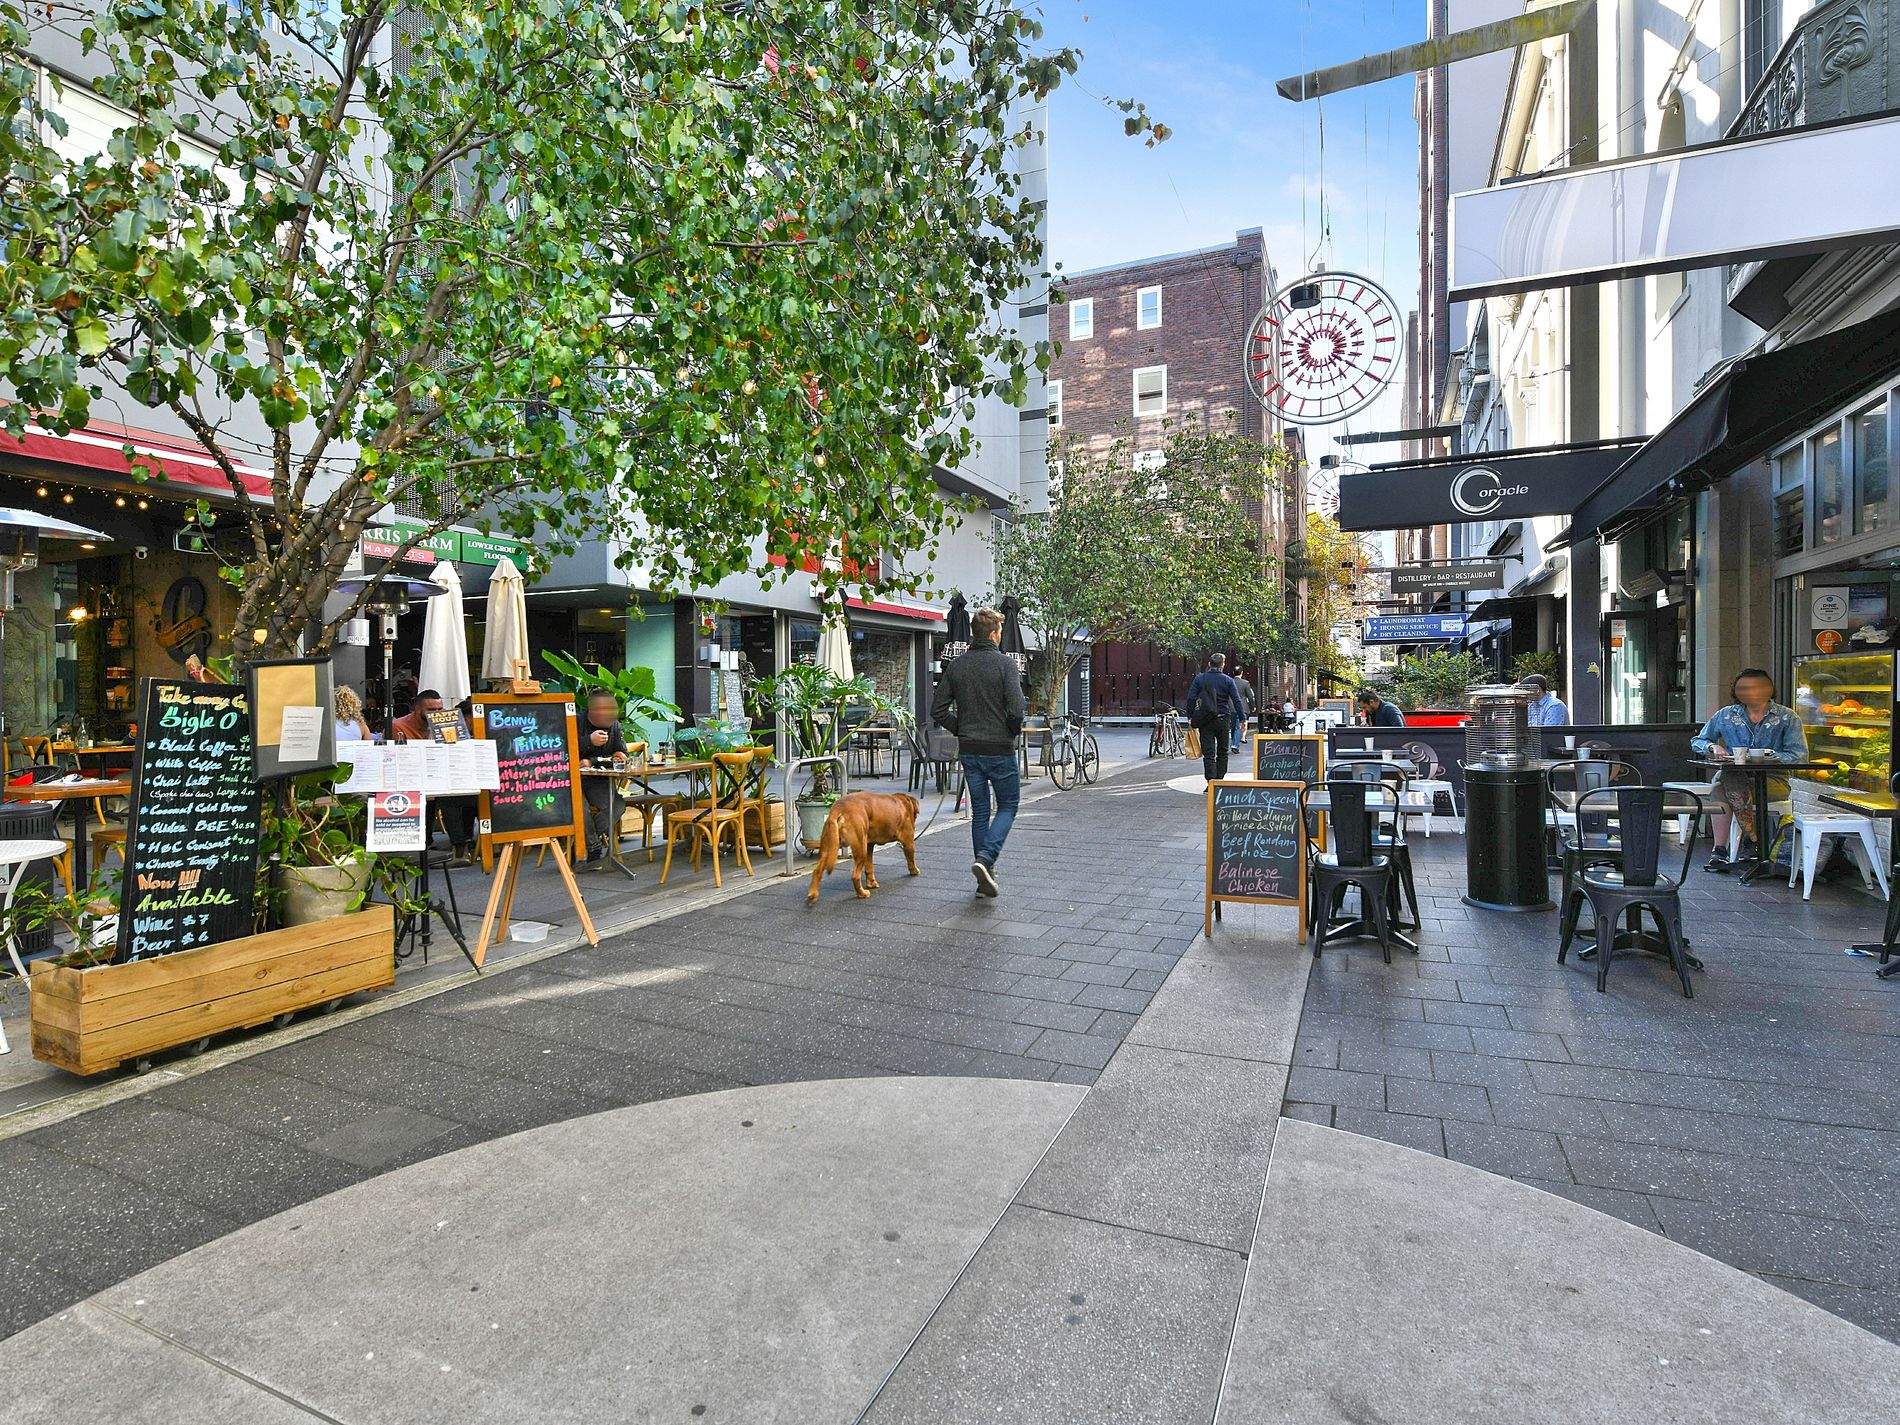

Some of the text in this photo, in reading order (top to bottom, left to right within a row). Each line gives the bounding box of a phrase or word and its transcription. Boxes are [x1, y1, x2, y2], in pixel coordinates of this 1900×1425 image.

[363, 544, 425, 560] MARTS
[467, 540, 521, 555] LOWER GROU
[1398, 571, 1497, 583] DISTILLERY BAR RESTAURANT
[156, 685, 192, 705] Take
[488, 708, 539, 734] Benny
[158, 738, 196, 752] Black
[199, 739, 238, 757] Coffee
[155, 757, 223, 771] White Coffee
[153, 774, 182, 788] Chai
[535, 794, 555, 810] $16
[1215, 788, 1299, 813] Lunch Special
[1217, 807, 1251, 822] Grilled
[1252, 808, 1293, 823] Salmon
[1267, 819, 1298, 835] Salad
[1222, 832, 1252, 850] Beef
[1218, 861, 1283, 880] Balinese
[137, 871, 176, 891] Now
[1227, 878, 1279, 894] Chicken
[135, 887, 240, 912] Available
[133, 915, 174, 935] Wine
[131, 935, 176, 954] Beer
